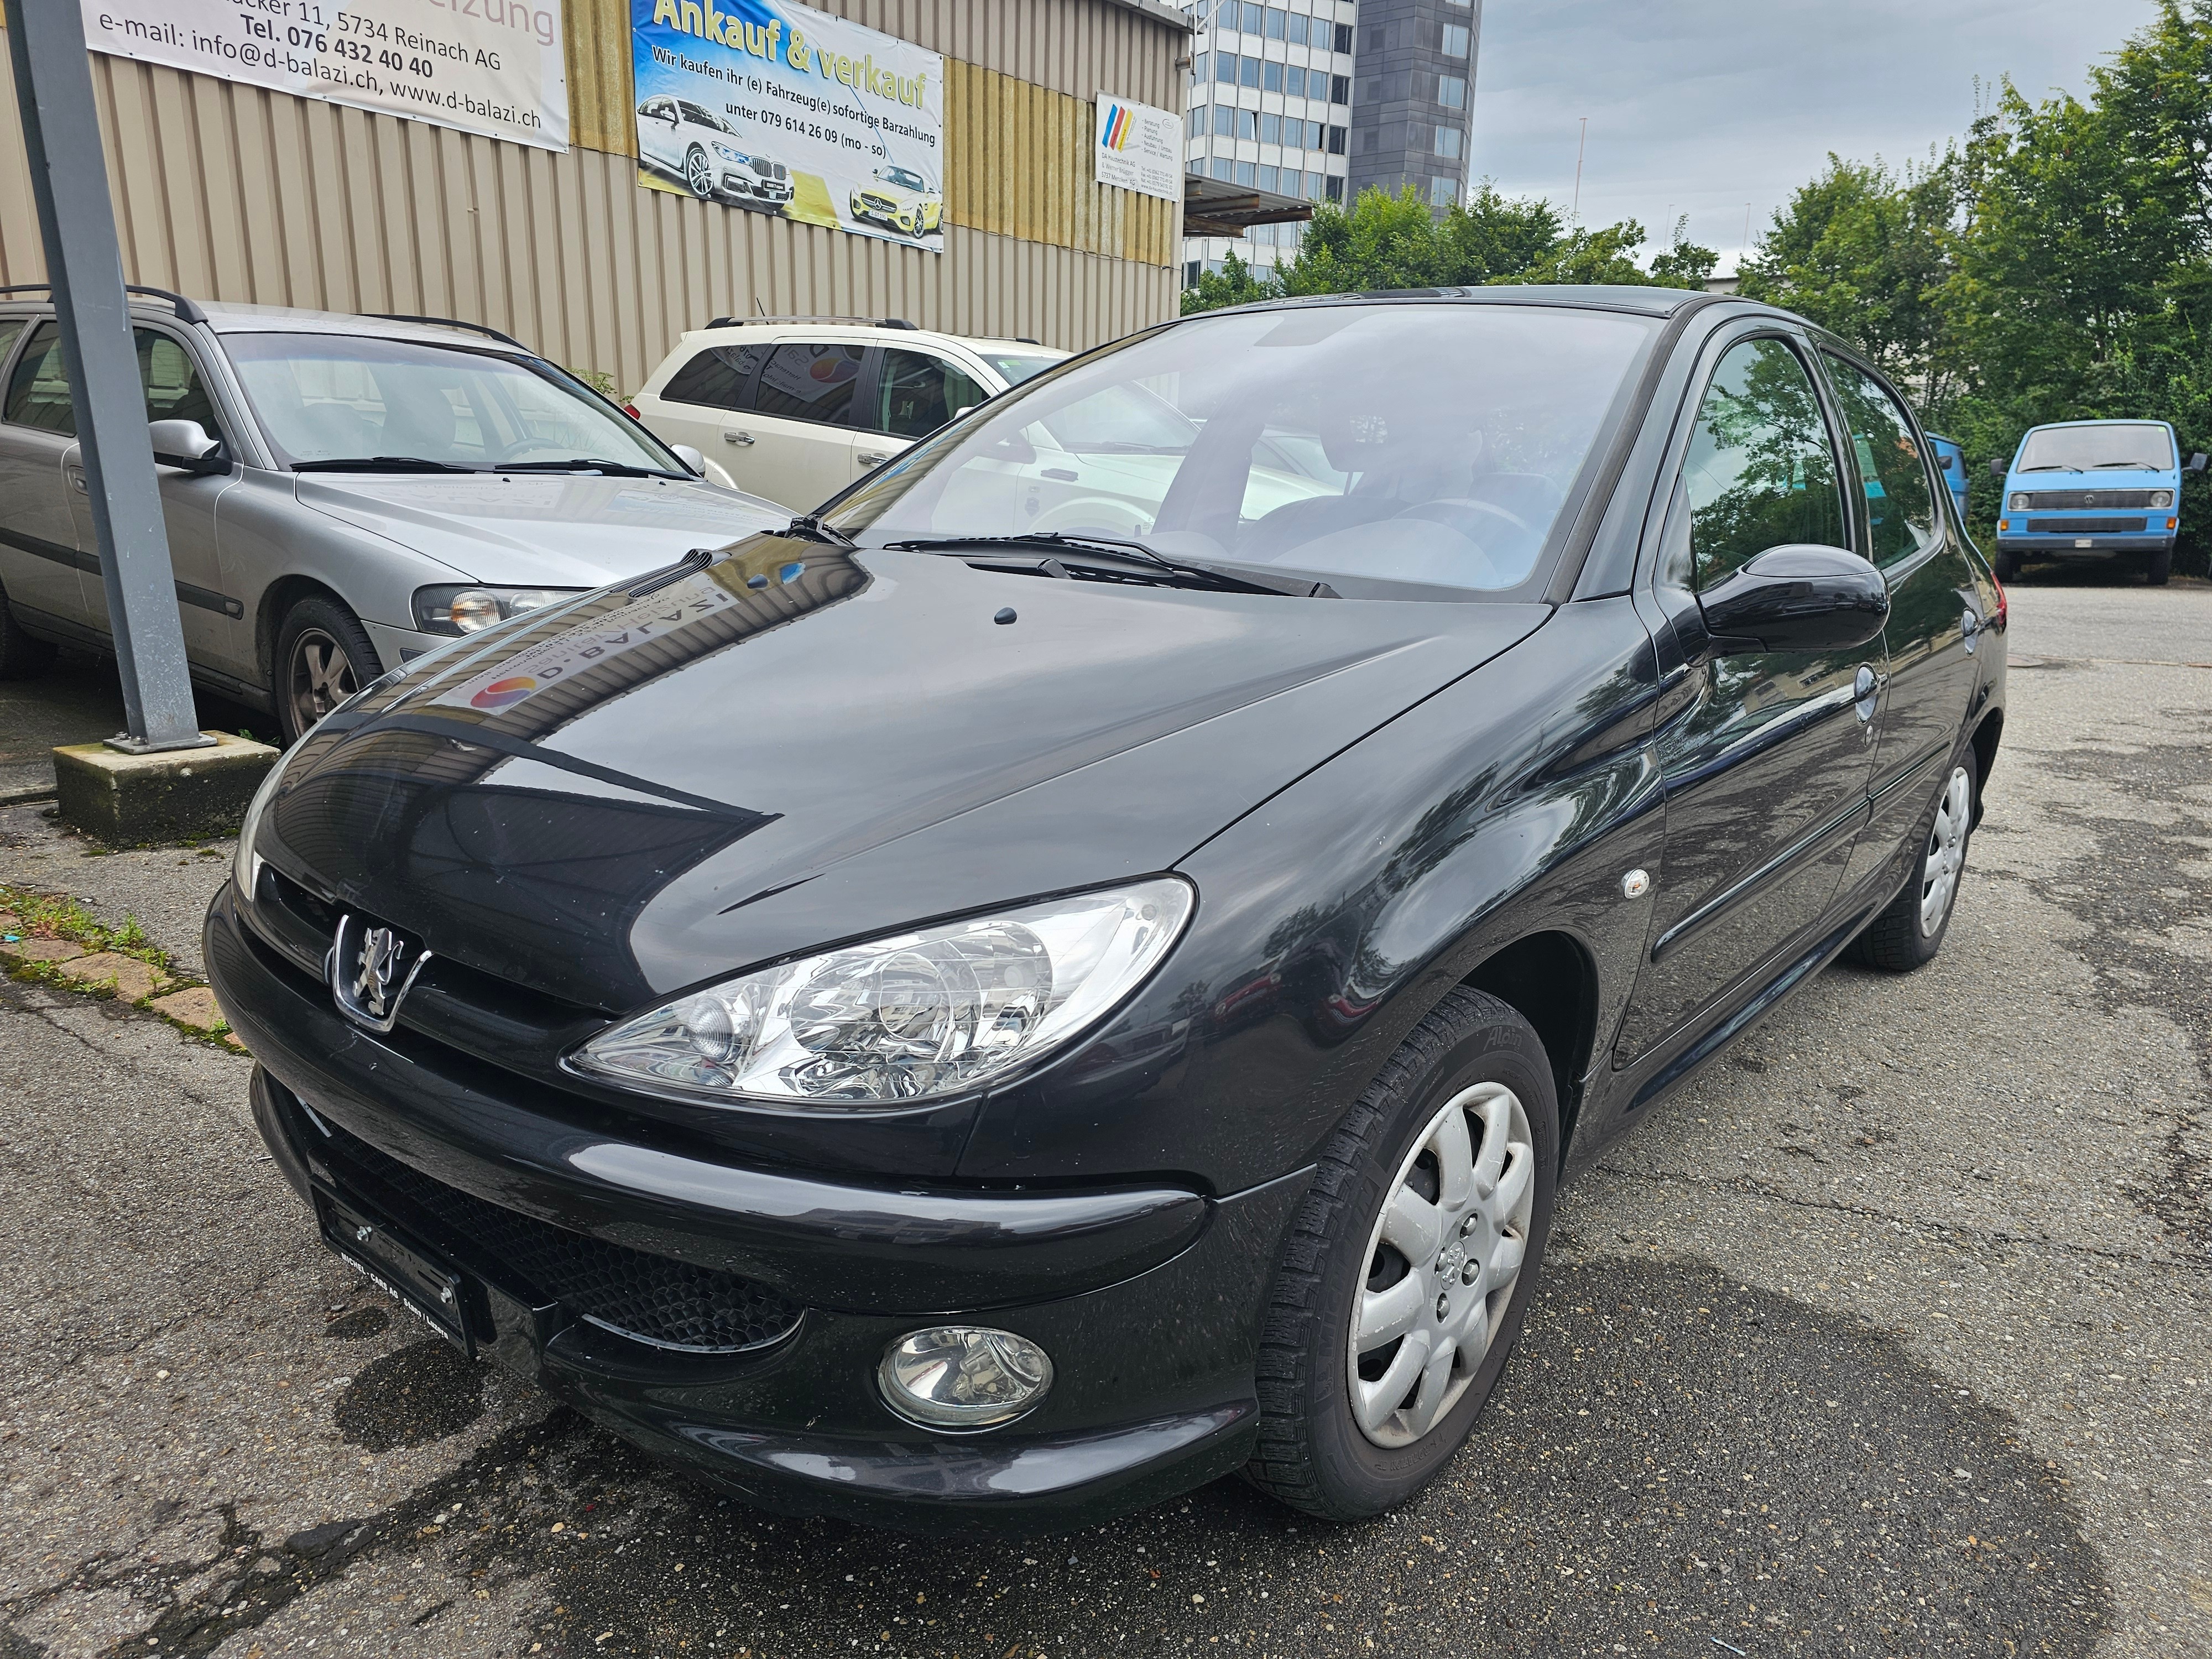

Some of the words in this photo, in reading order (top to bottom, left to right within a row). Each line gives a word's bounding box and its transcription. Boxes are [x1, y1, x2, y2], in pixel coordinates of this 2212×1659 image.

[240, 13, 280, 42] Tel.
[288, 27, 327, 53] 076
[334, 38, 373, 64] 432
[379, 50, 403, 71] 40
[409, 57, 433, 78] 40
[299, 2, 330, 31] 11,
[338, 12, 388, 41] 5734
[395, 27, 468, 62] Reinach
[475, 49, 501, 70] AG
[653, 0, 781, 60] Ankauf
[789, 29, 812, 72] &
[817, 45, 927, 108] verkauf
[100, 13, 185, 47] e-mail:
[192, 30, 384, 96] info@d-balazi.ch,
[390, 81, 541, 128] www.d-balazi.ch
[652, 45, 676, 66] Wir
[681, 53, 723, 80] kaufen
[726, 68, 742, 86] ihr
[747, 74, 762, 94] (e)
[766, 81, 831, 114] Fahrzeug(e)
[833, 102, 880, 128] sofortige
[882, 117, 936, 147] Barzahlung
[726, 102, 758, 121] unter
[761, 109, 782, 127] 079
[785, 116, 805, 134] 614
[808, 123, 822, 139] 26
[825, 128, 838, 144] 09
[841, 132, 862, 150] (mo
[871, 142, 886, 159] so)
[389, 1287, 399, 1299] AG
[403, 1298, 422, 1317] Stans
[426, 1316, 448, 1339] Luzern
